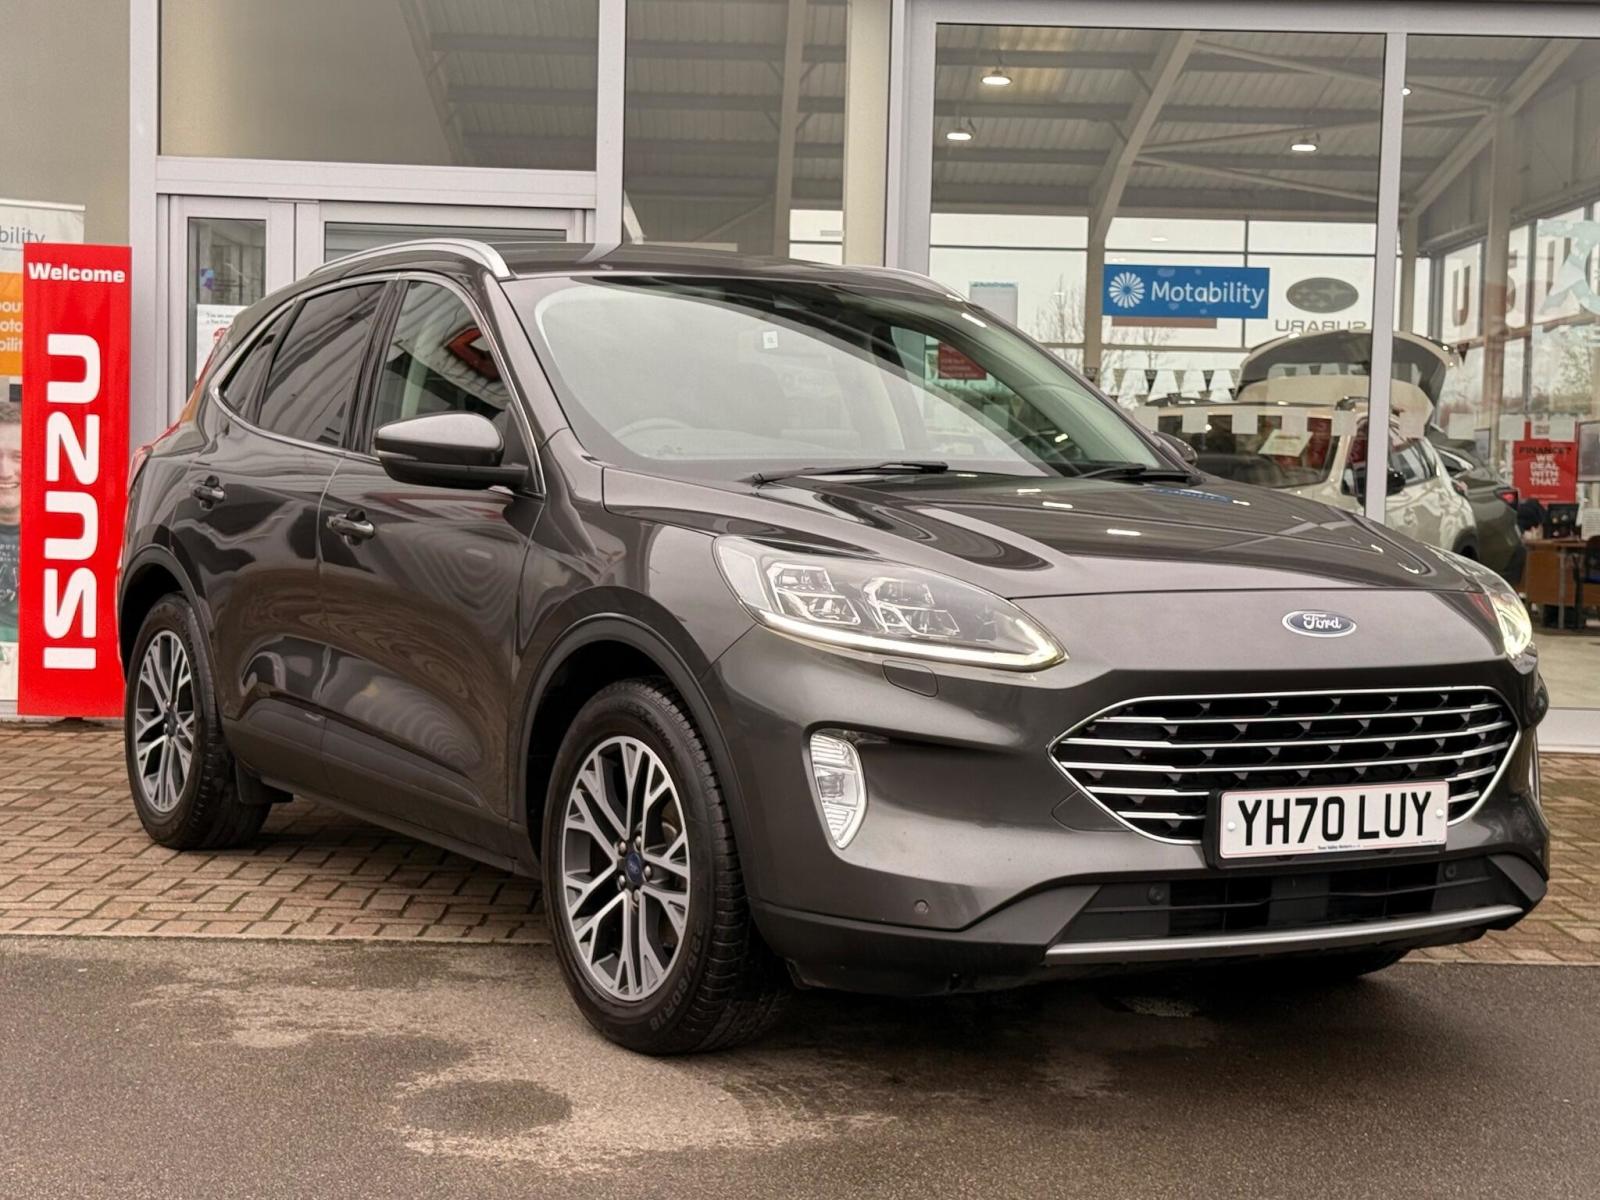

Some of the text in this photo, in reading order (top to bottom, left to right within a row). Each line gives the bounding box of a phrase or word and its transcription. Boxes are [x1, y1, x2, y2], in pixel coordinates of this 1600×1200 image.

[28, 262, 126, 284] Welcome
[1151, 281, 1265, 309] Motability
[43, 333, 101, 671] ISUZU
[1303, 613, 1342, 630] Ford
[1238, 791, 1432, 847] YH70 LUY
